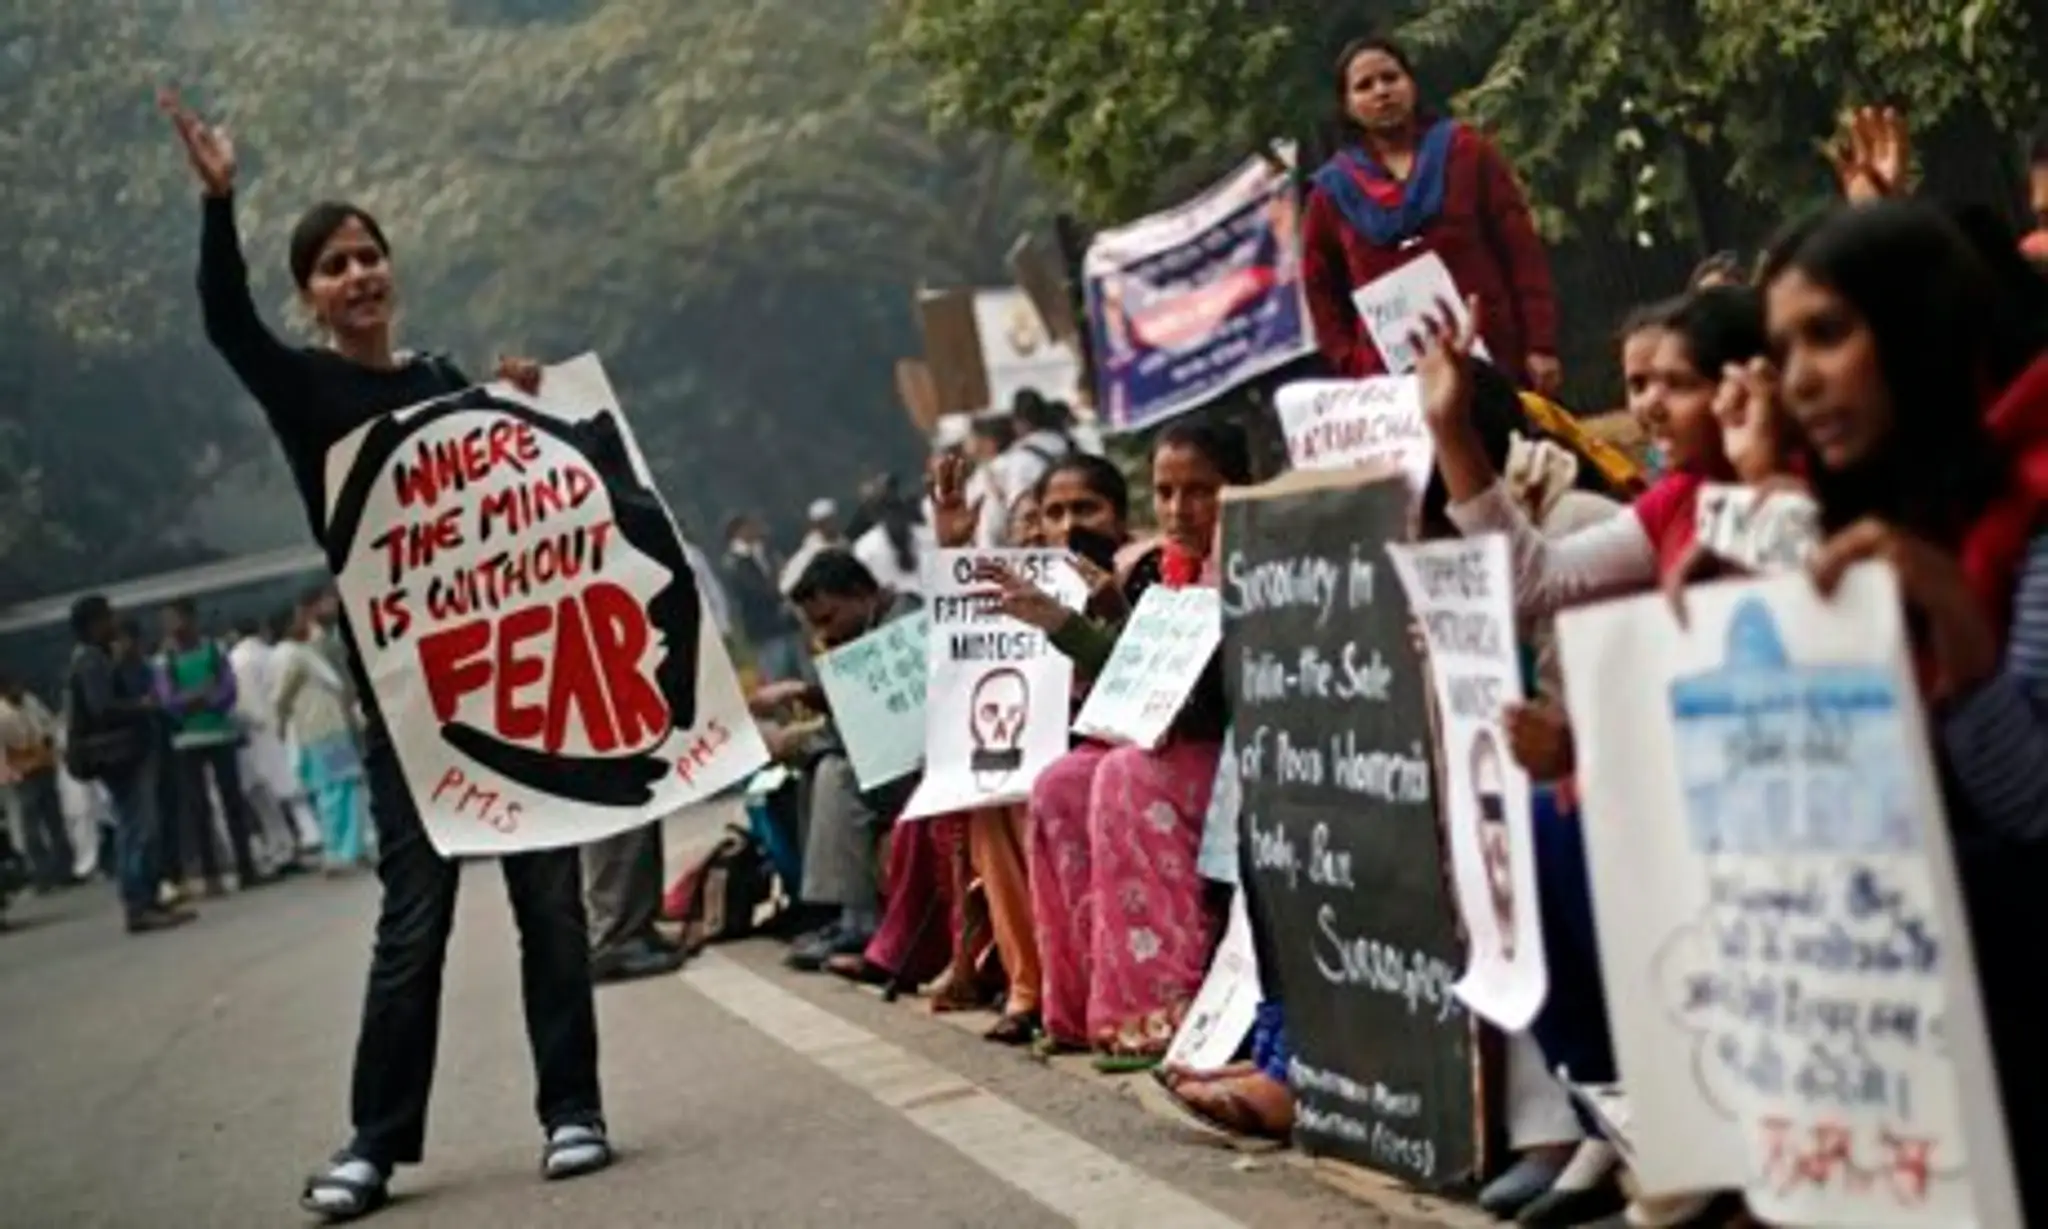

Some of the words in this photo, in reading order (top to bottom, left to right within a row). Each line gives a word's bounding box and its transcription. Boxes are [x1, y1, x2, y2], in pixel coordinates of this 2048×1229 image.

[371, 507, 464, 584] THE
[480, 465, 596, 543] MIND
[394, 420, 541, 507] WHERE
[370, 589, 411, 648] IS
[426, 520, 612, 619] WITHOUT
[417, 581, 669, 755] FEAR
